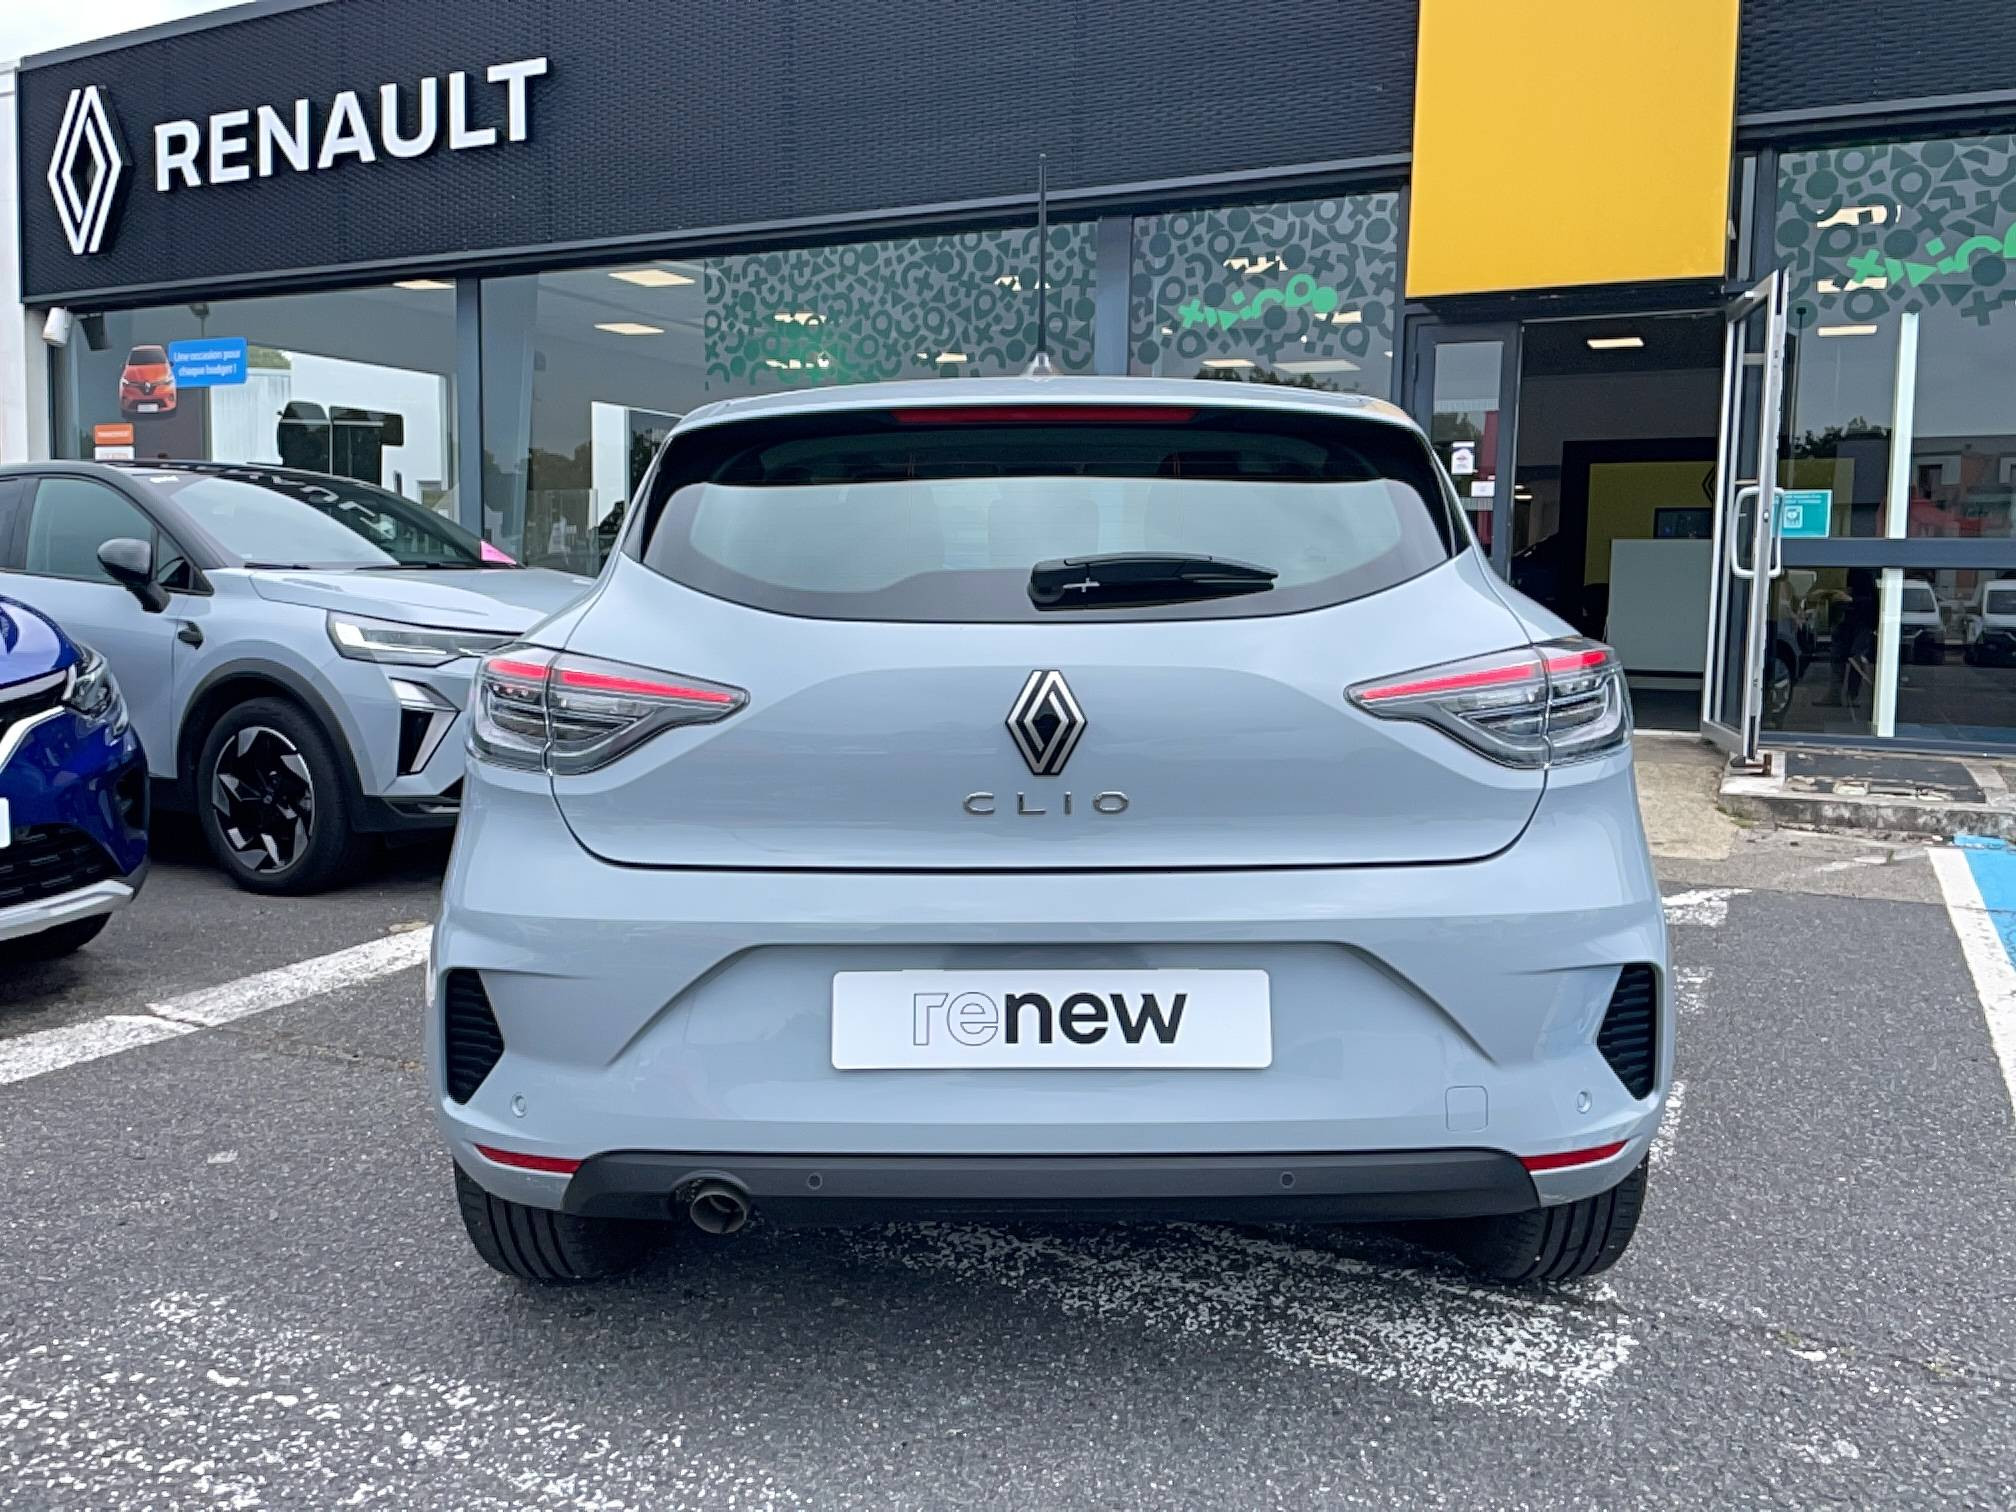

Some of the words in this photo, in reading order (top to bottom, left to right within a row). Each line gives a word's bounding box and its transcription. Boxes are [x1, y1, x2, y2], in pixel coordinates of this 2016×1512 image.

[154, 57, 548, 192] RENAULT
[963, 791, 1129, 815] CLIO
[912, 991, 1188, 1046] renew
